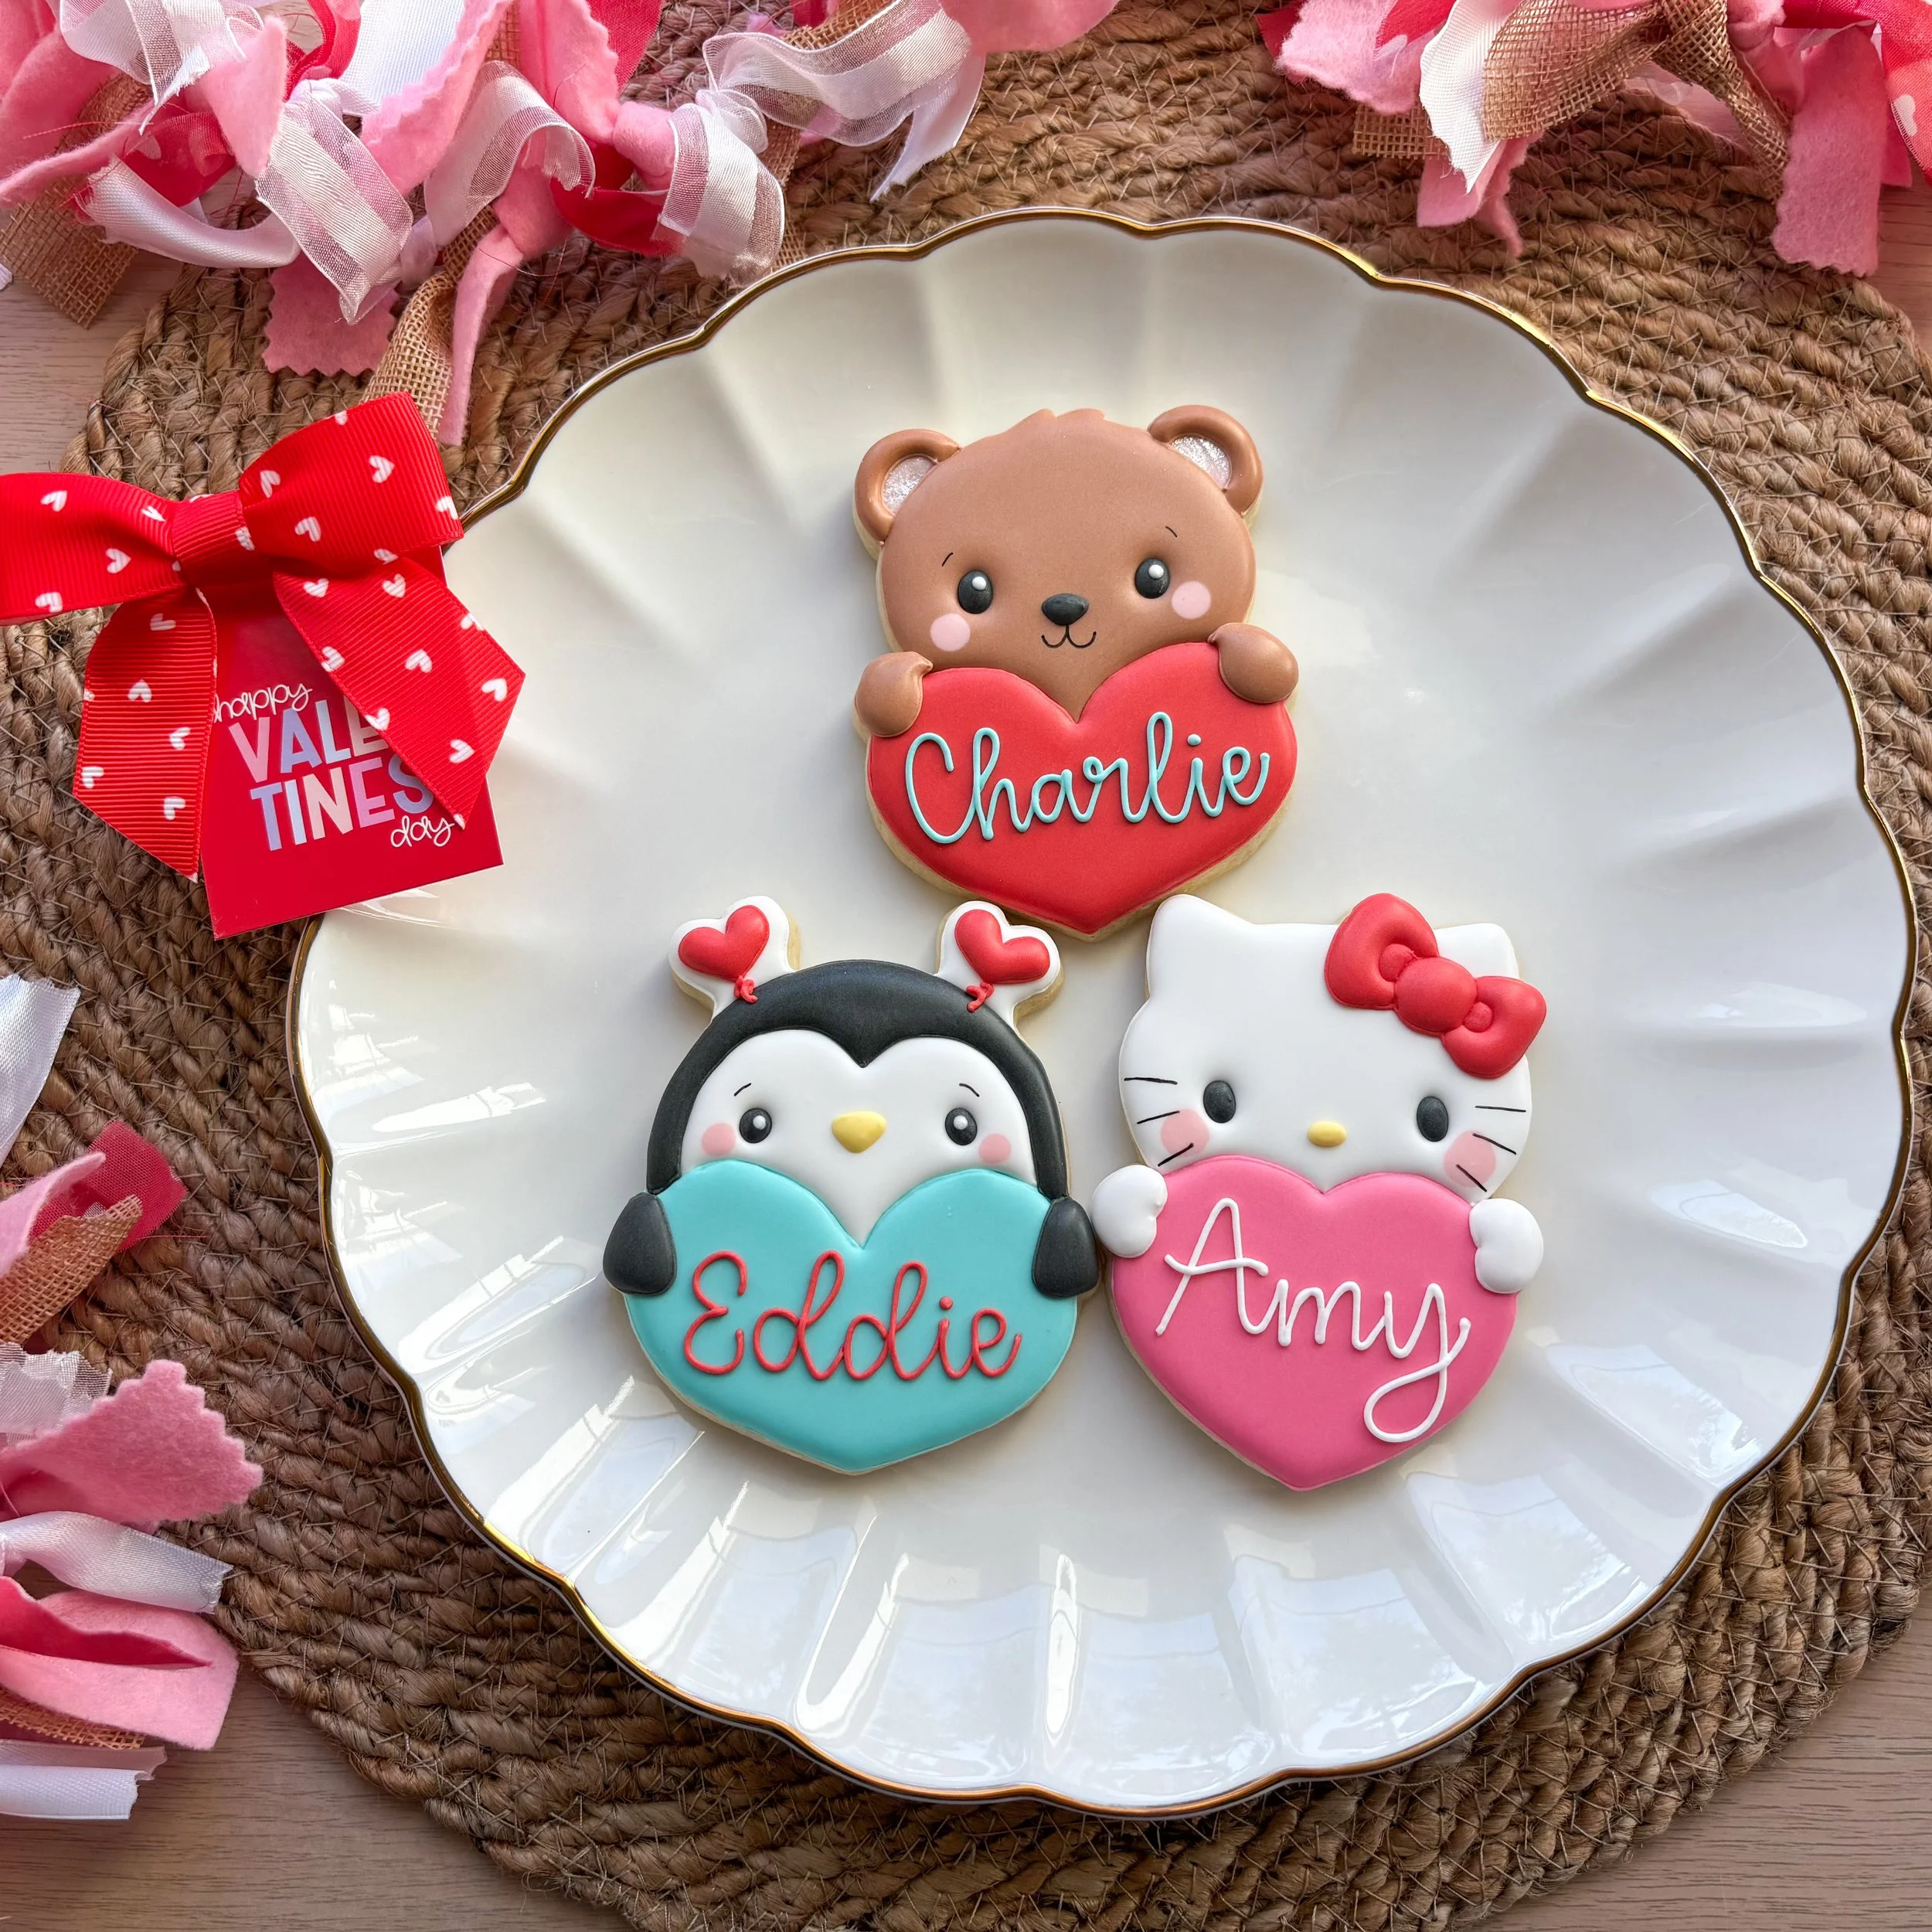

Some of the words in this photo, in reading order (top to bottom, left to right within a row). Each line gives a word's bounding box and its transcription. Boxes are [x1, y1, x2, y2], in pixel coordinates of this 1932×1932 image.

[213, 683, 312, 723] happy
[228, 695, 390, 783] VALE
[250, 754, 434, 852] TINES
[905, 712, 1270, 844] Charlie
[390, 815, 455, 848] day
[683, 1250, 1022, 1380] Eddie
[1155, 1197, 1471, 1443] Amy
